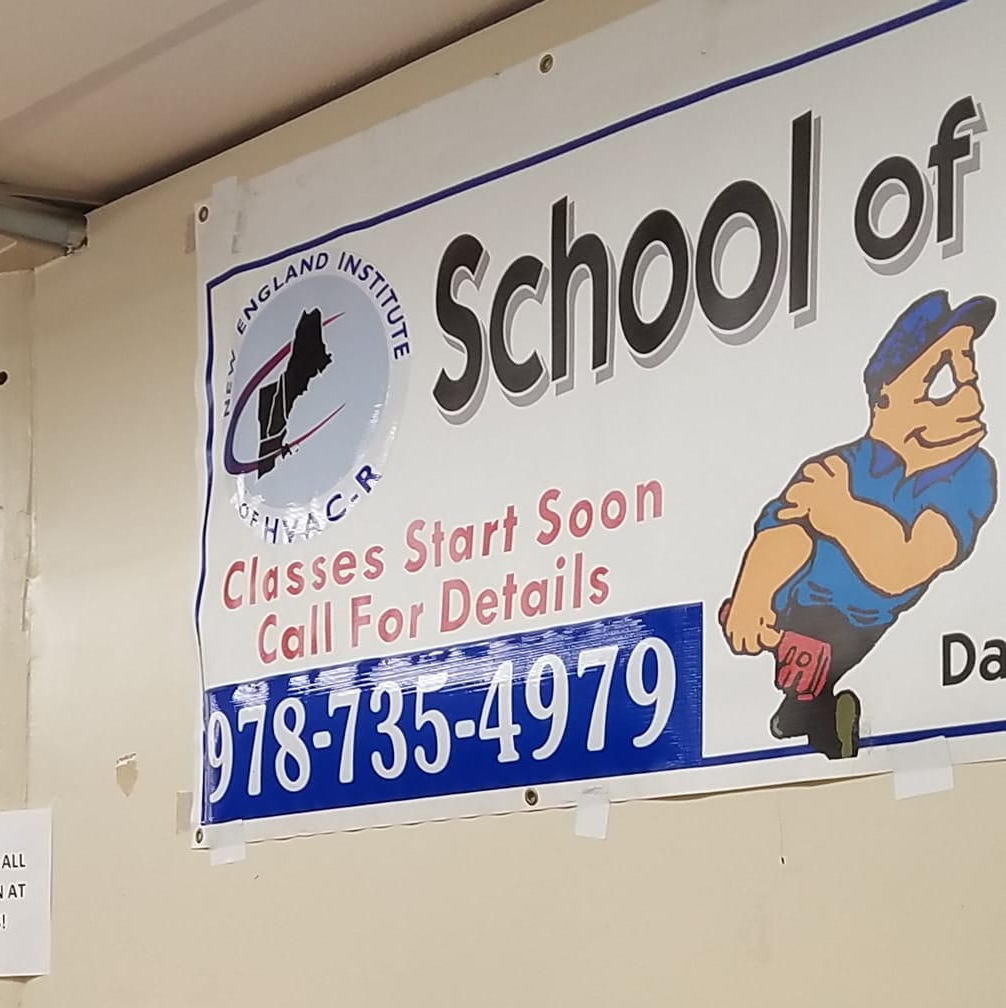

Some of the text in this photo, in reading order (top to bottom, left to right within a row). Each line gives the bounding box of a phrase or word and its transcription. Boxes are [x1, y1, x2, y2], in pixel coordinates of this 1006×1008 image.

[432, 96, 988, 425] School of
[223, 251, 410, 418] NEW ENGLAND INSTITUTE
[223, 479, 663, 610] Classes Start Soon
[239, 503, 260, 526] OF
[258, 552, 610, 665] Call For Details
[942, 632, 1006, 686] Da
[205, 637, 678, 804] 978-735-4979
[2, 853, 26, 869] ALL
[8, 883, 26, 899] AT
